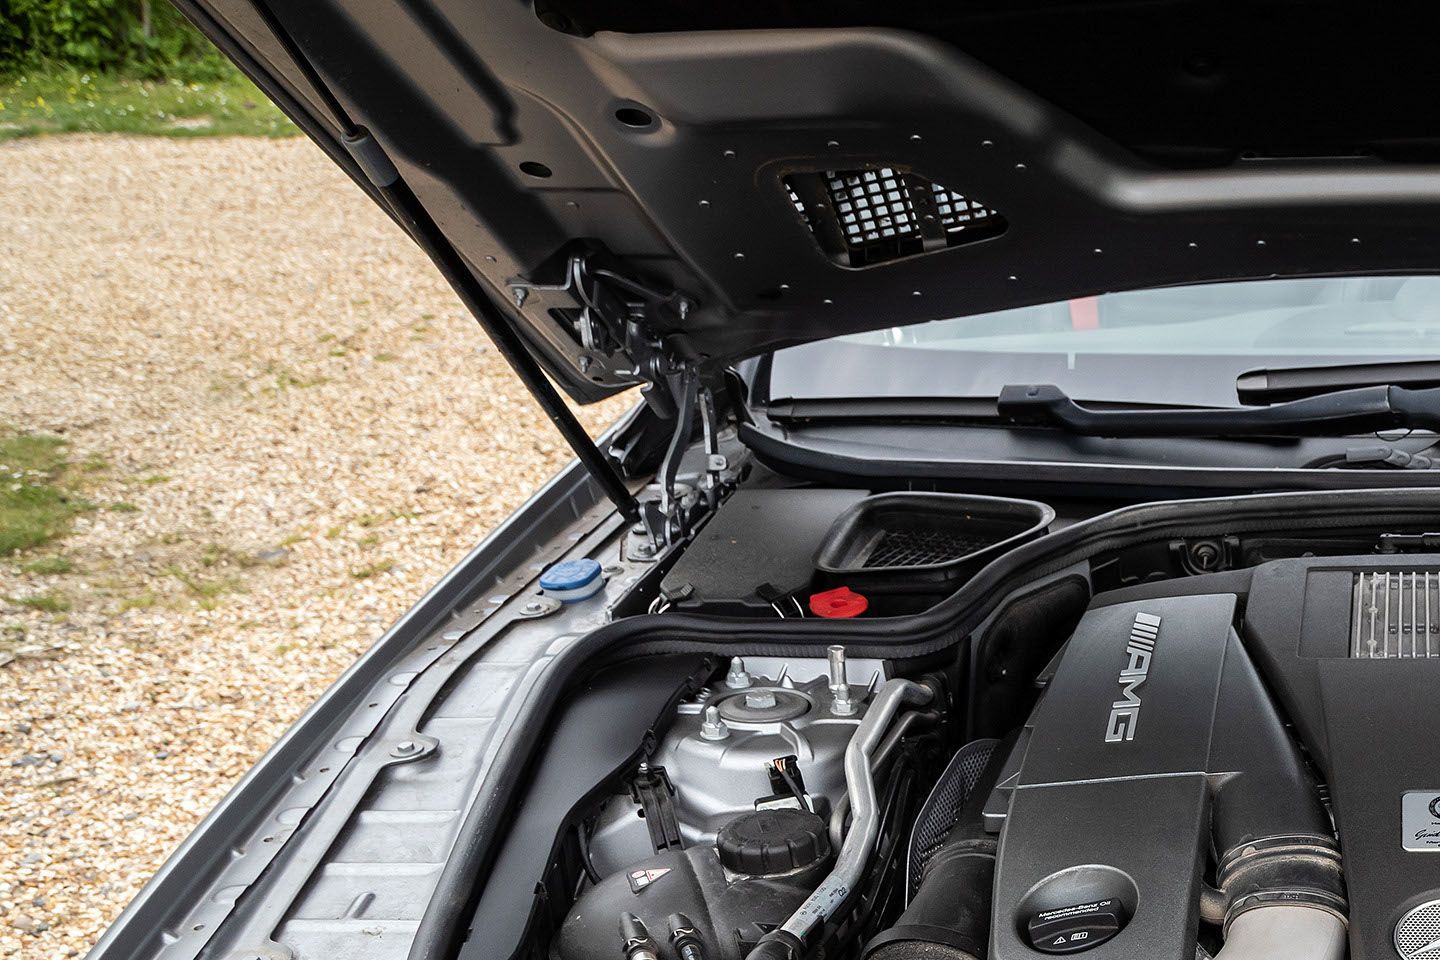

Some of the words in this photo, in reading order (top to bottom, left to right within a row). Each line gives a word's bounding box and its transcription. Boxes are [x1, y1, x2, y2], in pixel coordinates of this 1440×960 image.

[1105, 647, 1153, 742] AMG
[1038, 902, 1098, 918] Mercedes-Benz
[1044, 906, 1100, 920] recommended
